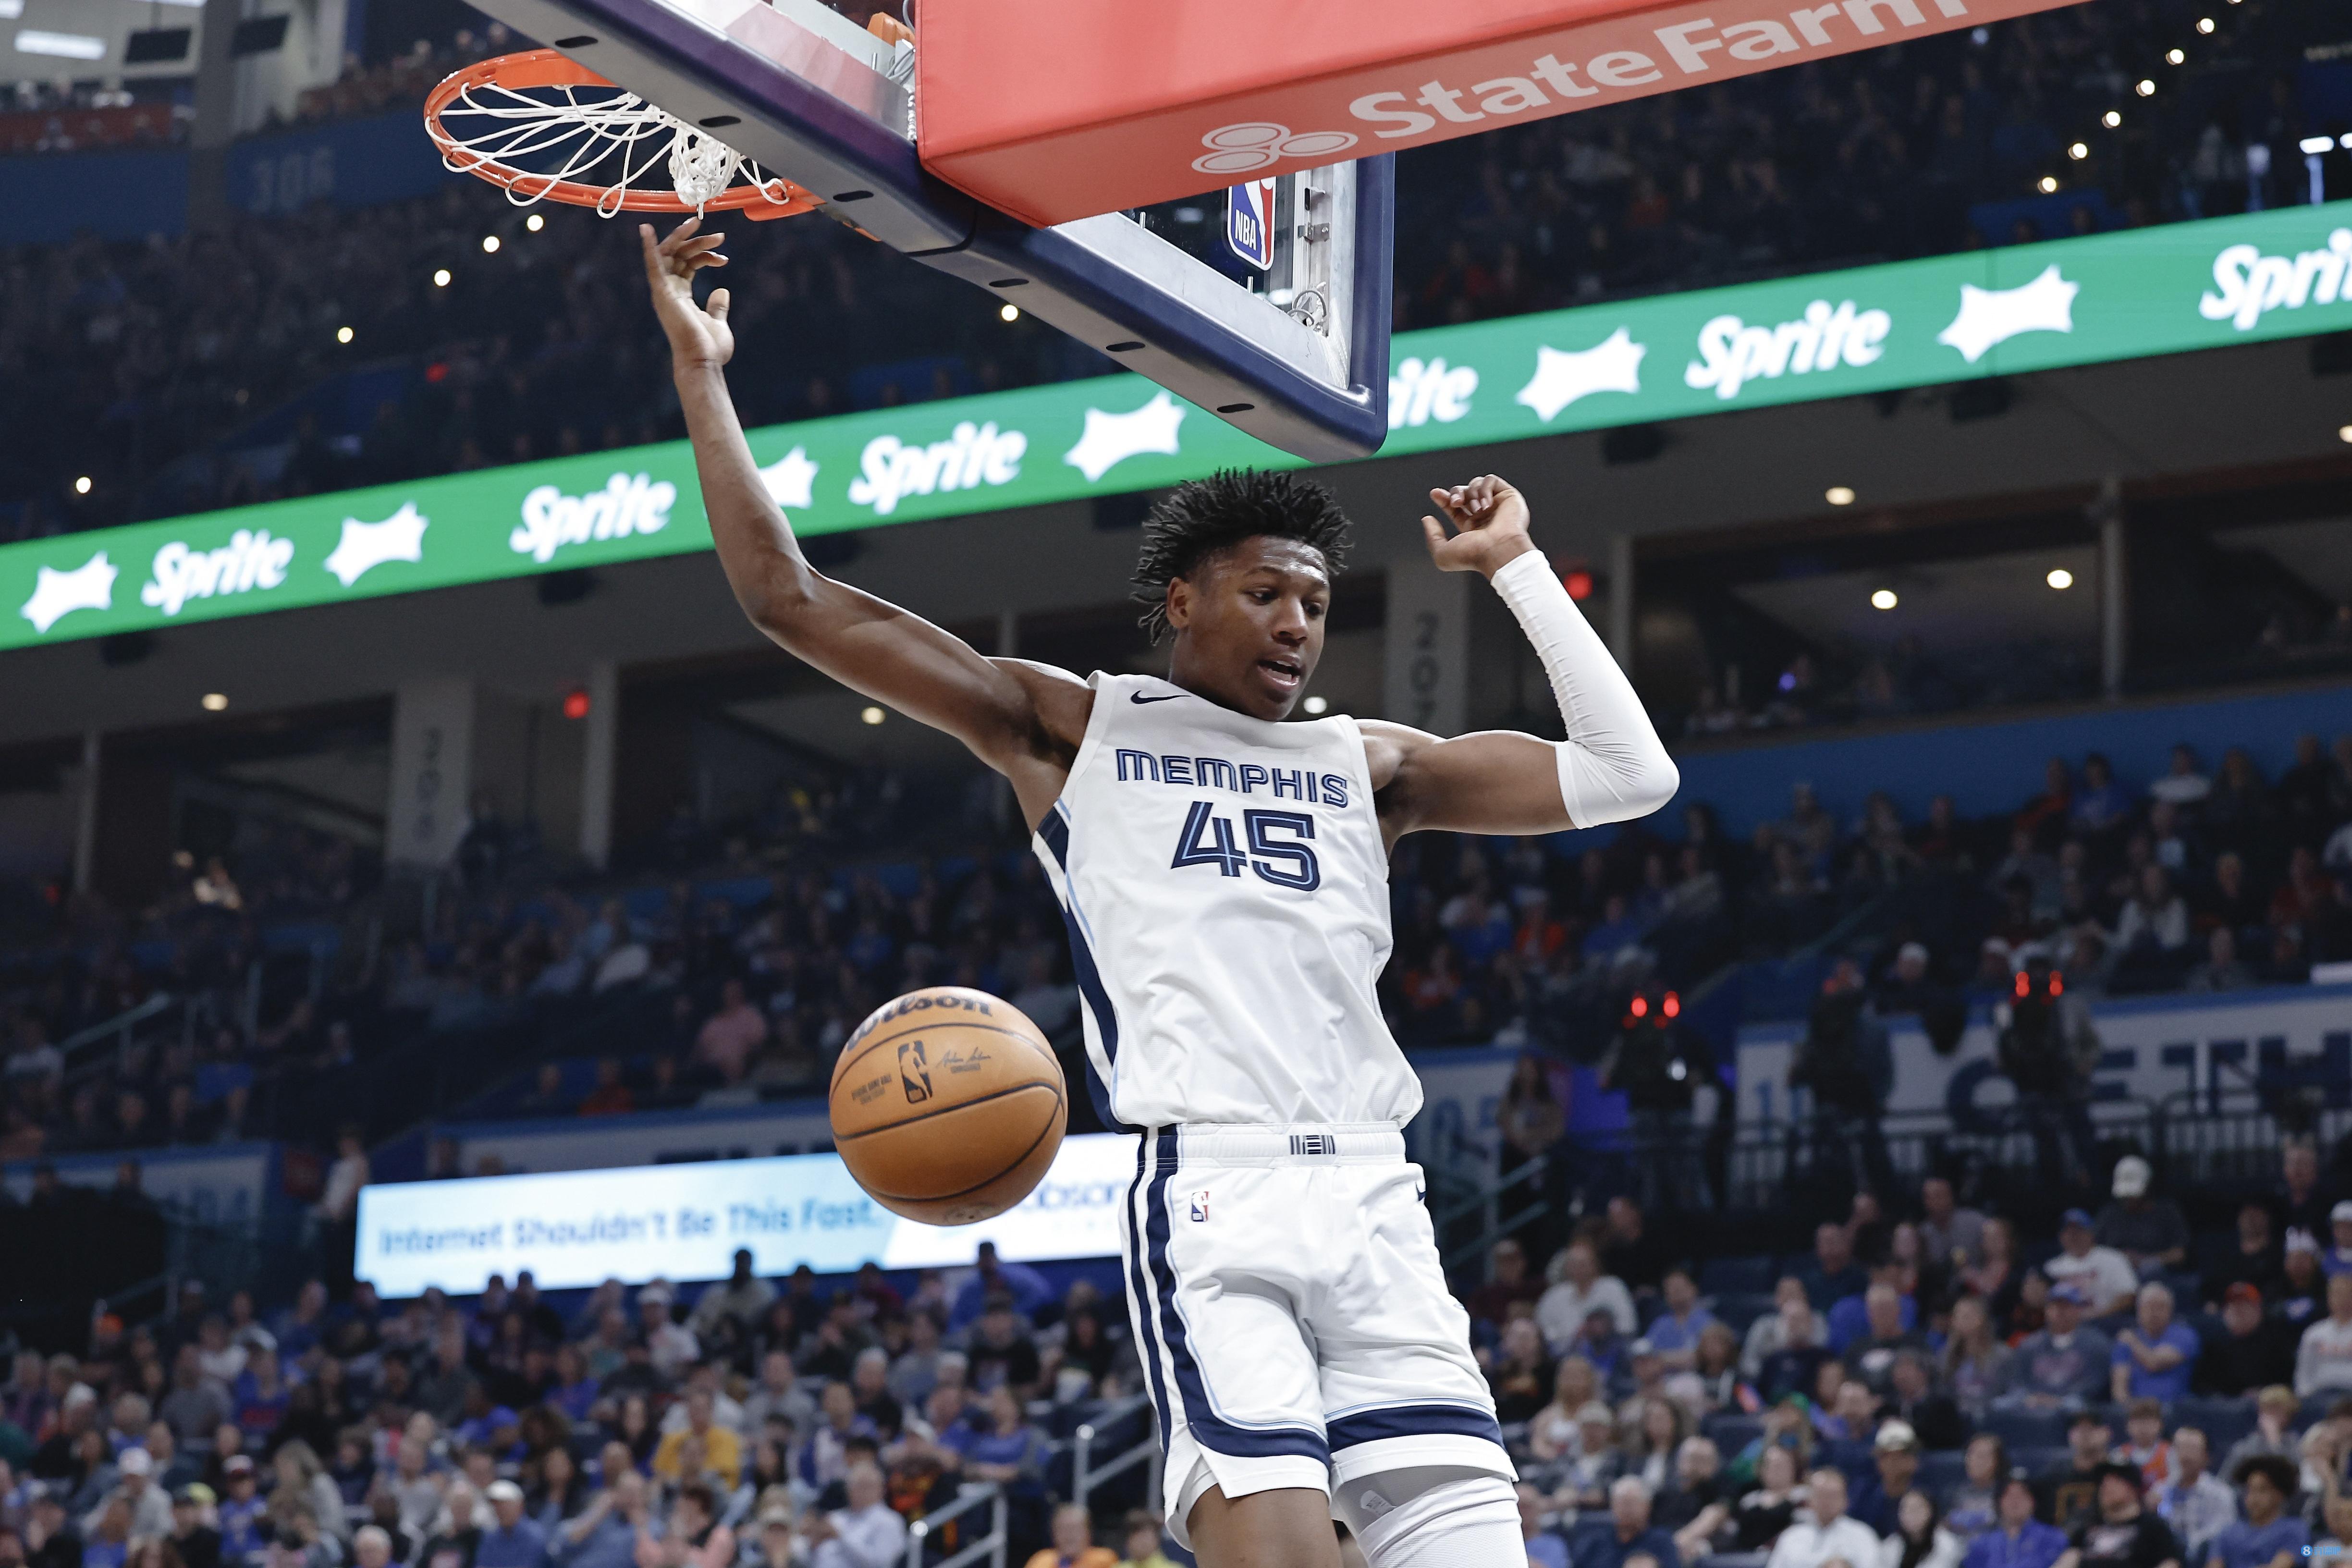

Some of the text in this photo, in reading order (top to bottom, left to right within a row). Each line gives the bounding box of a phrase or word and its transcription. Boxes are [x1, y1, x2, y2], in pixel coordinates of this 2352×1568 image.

[1235, 208, 1257, 251] NBA
[2199, 227, 2352, 331] Spri
[1684, 300, 1891, 400] Sprite
[848, 421, 1027, 515] Sprite
[509, 472, 676, 563] Sprite
[141, 529, 294, 615] Sprite
[1115, 748, 1348, 808] MEMPHIS
[1170, 801, 1320, 892] 45
[379, 1223, 502, 1255] Internet
[677, 1207, 714, 1240] Be
[729, 1200, 791, 1234] This
